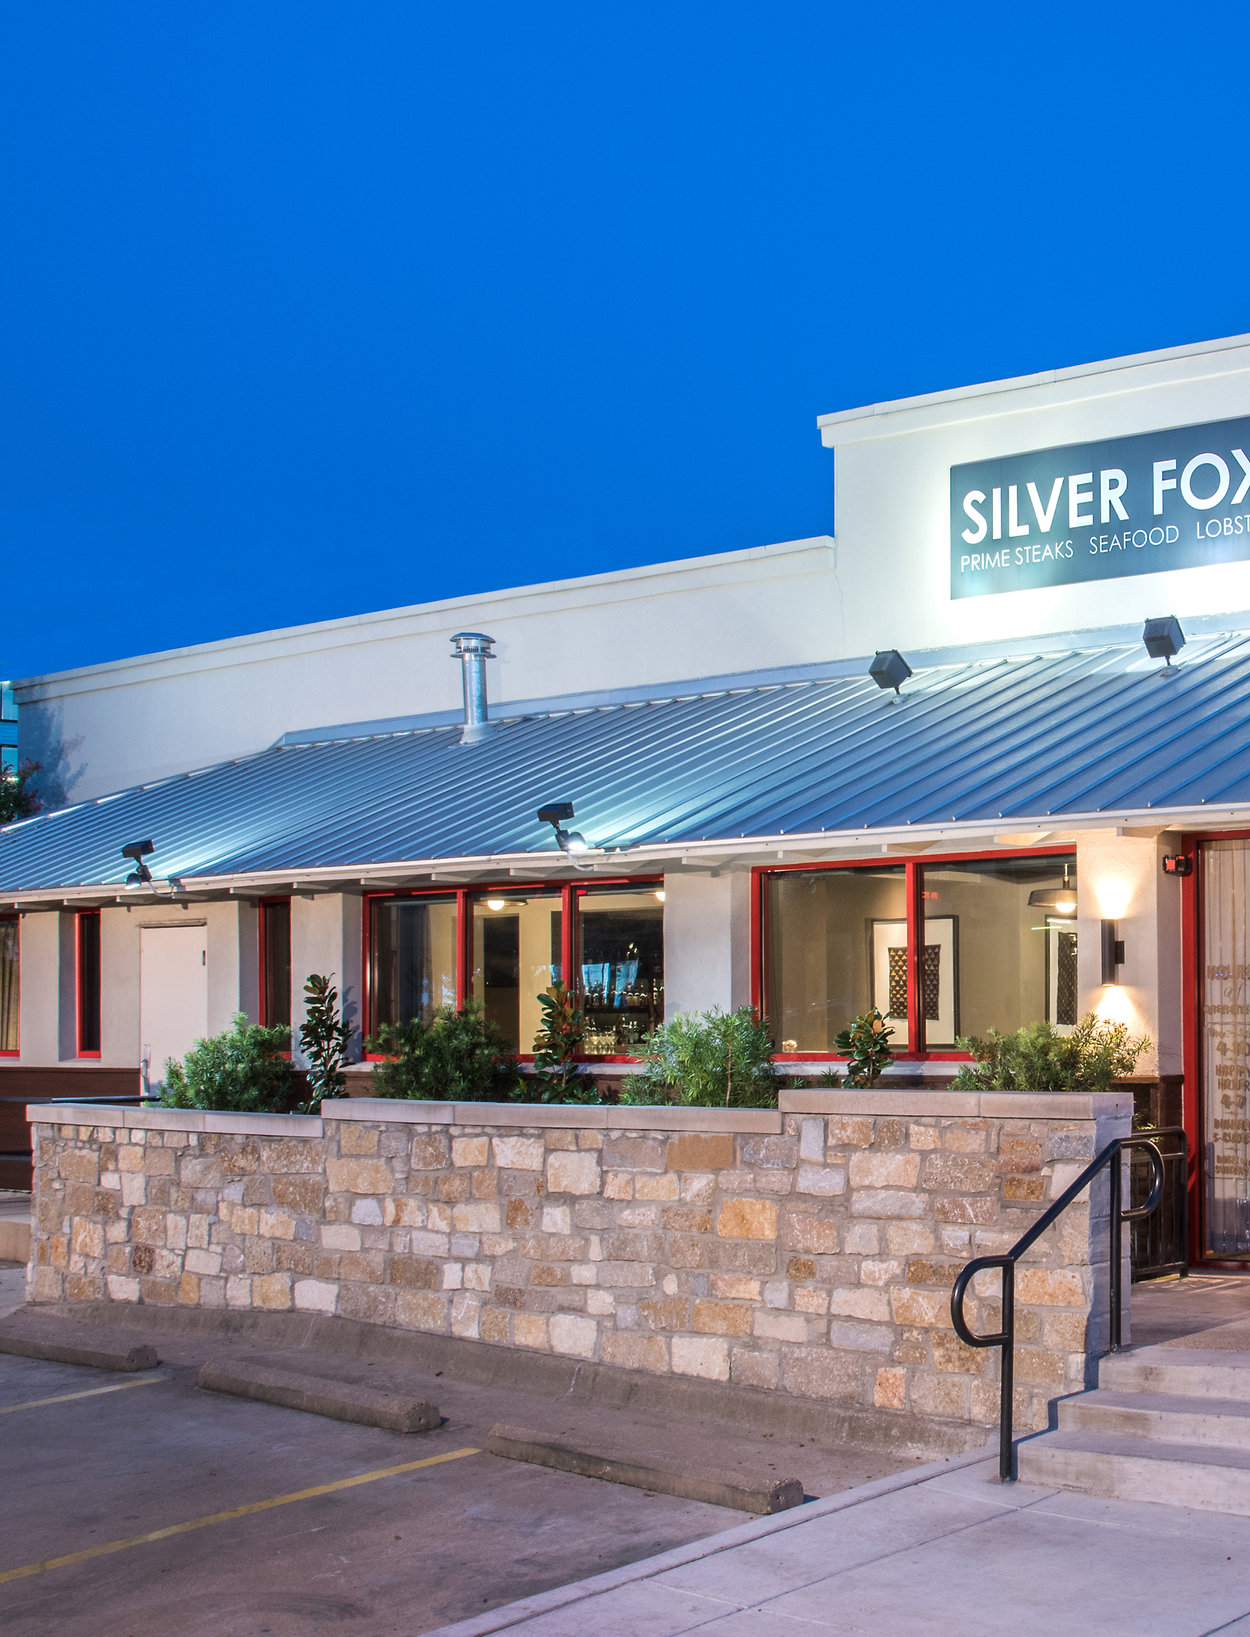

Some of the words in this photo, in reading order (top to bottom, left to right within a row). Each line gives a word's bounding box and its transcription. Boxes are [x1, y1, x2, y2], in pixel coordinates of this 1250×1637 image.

[961, 467, 1129, 545] SILVER
[961, 549, 1011, 573] PRIME
[1015, 540, 1074, 566] STEAKS
[1089, 525, 1179, 555] SEAFOOD
